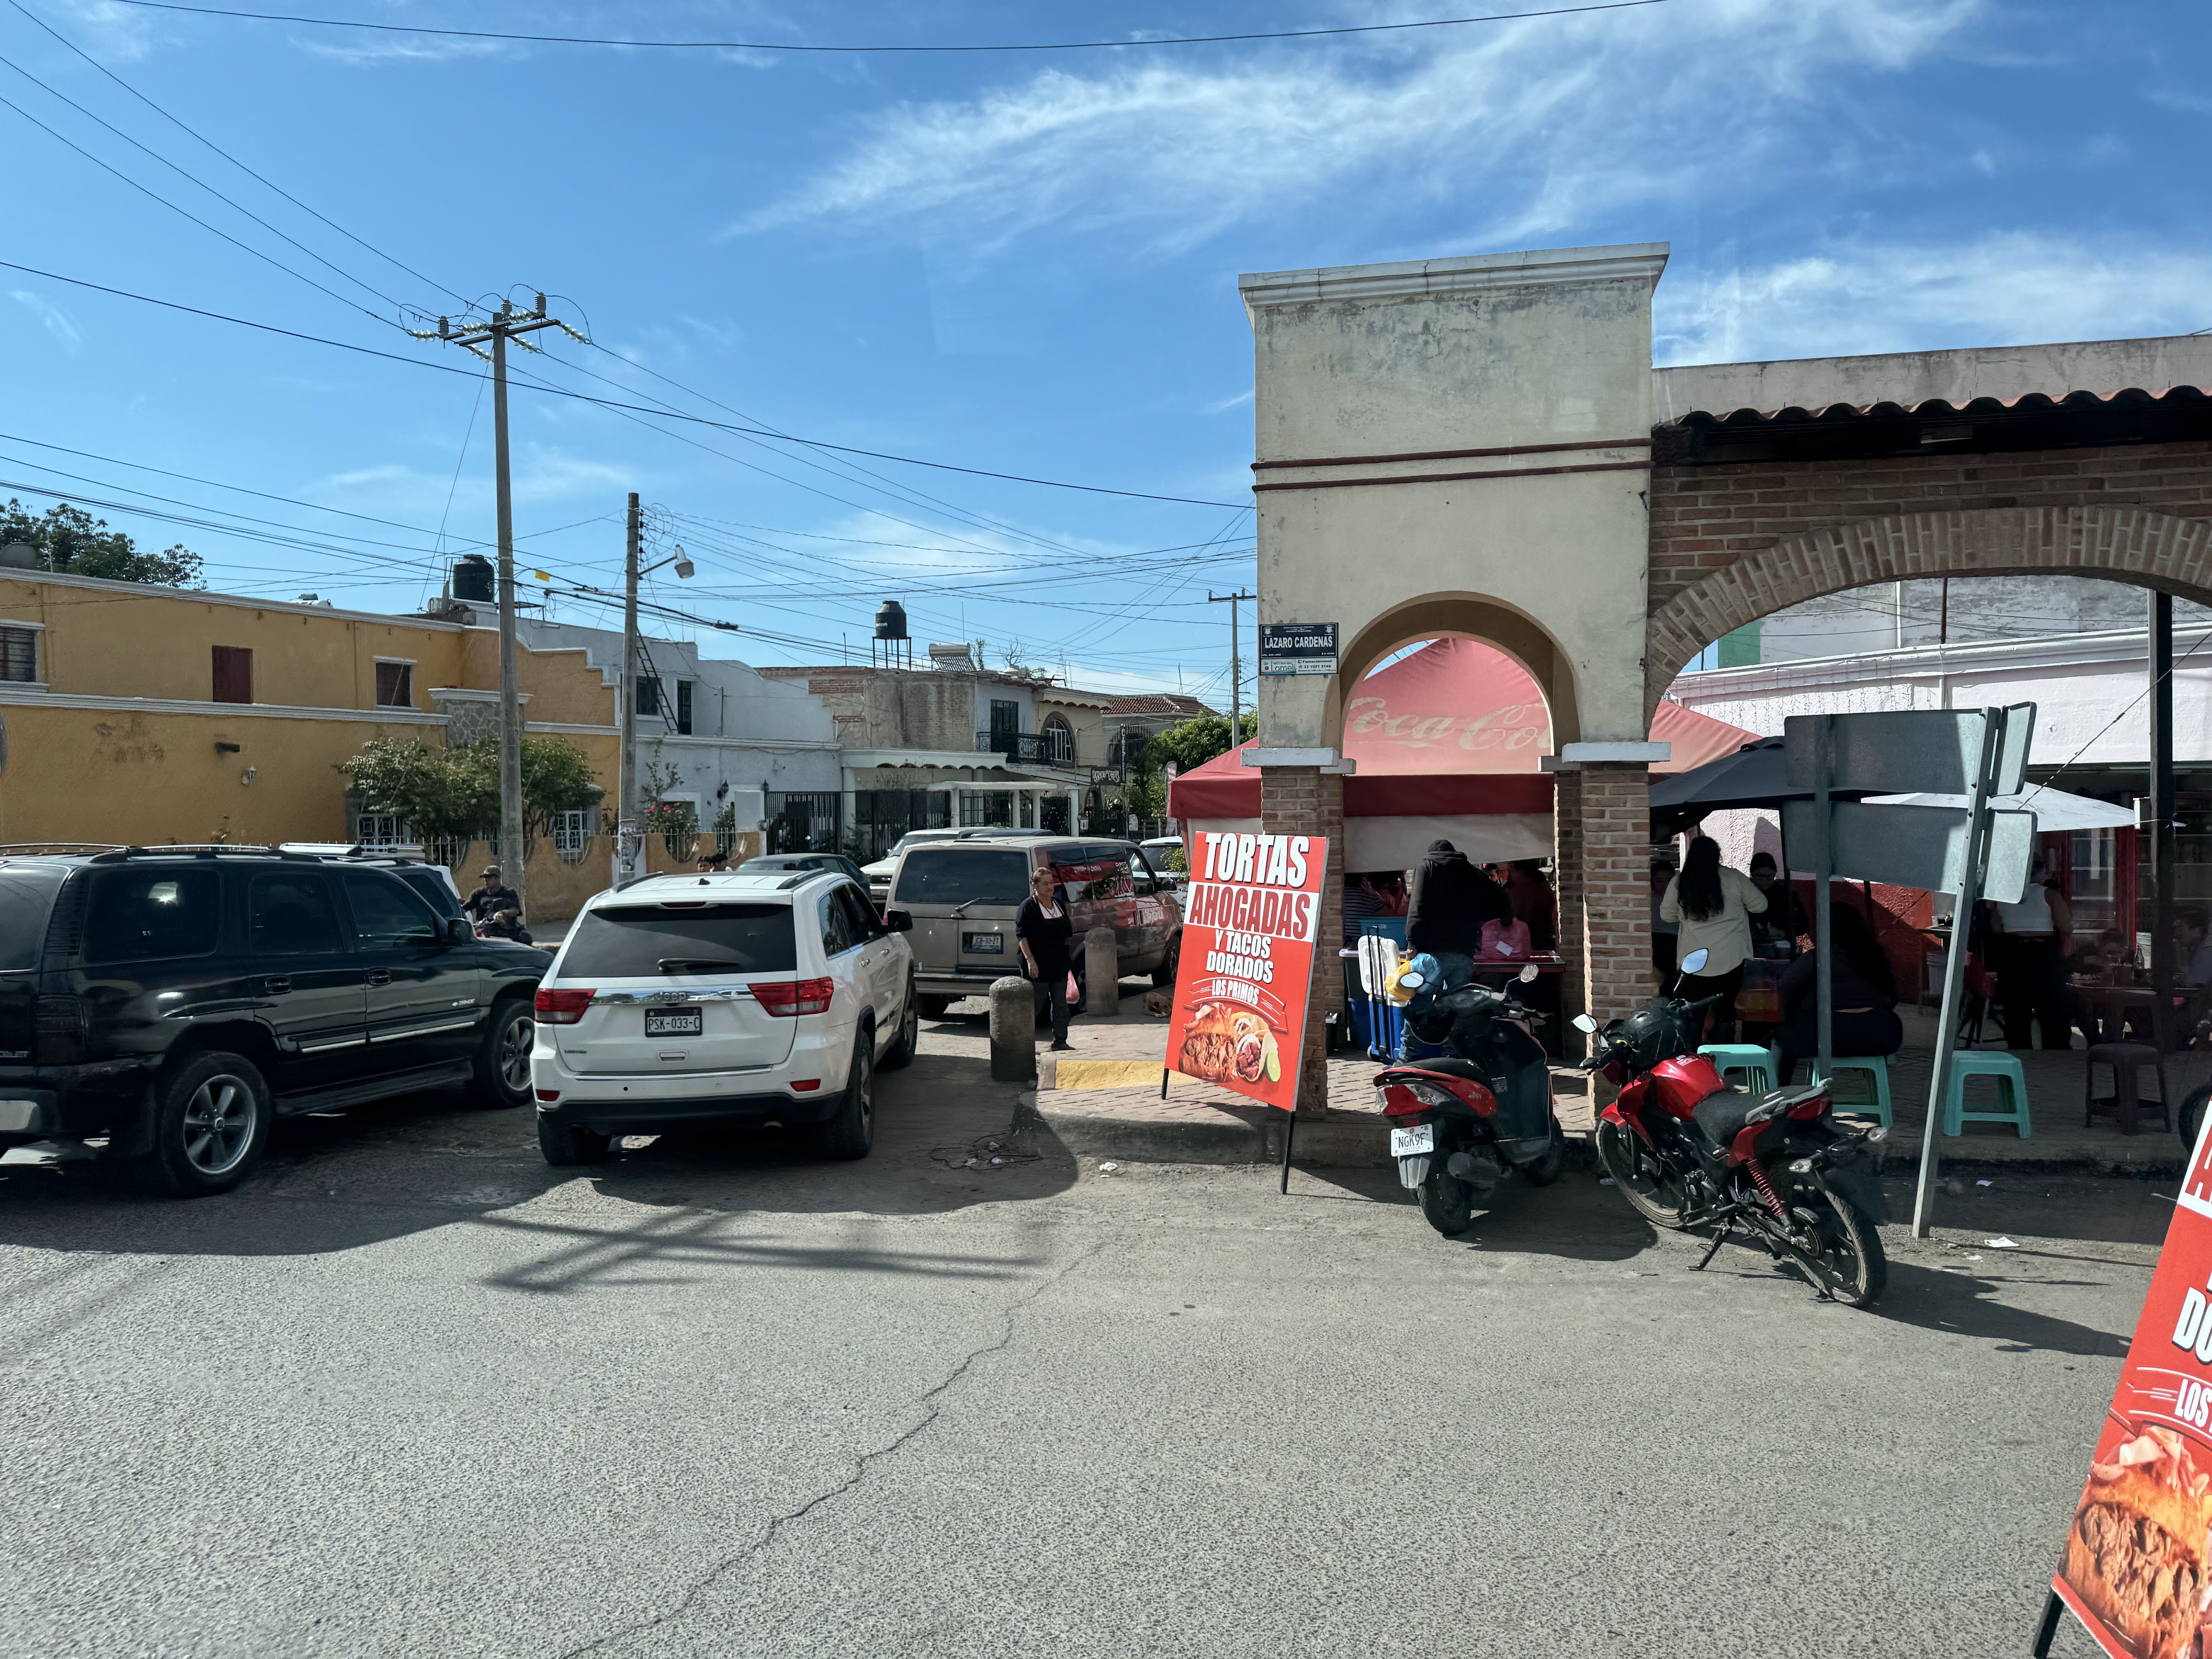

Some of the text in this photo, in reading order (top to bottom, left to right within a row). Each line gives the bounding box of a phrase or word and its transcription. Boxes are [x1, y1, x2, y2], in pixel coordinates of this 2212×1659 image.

[1265, 635, 1333, 648] LAZARO CARDENAS
[1205, 833, 1309, 888] TORTAS
[1189, 884, 1310, 940] AHOGADAS
[1215, 929, 1272, 959] Y TACOS
[1206, 950, 1274, 983] DORADOS
[1212, 979, 1259, 1005] LOS PRIMOS
[648, 1017, 700, 1030] PSK-033-C
[1398, 1132, 1425, 1148] NGK9F
[2174, 1378, 2212, 1428] LOS
